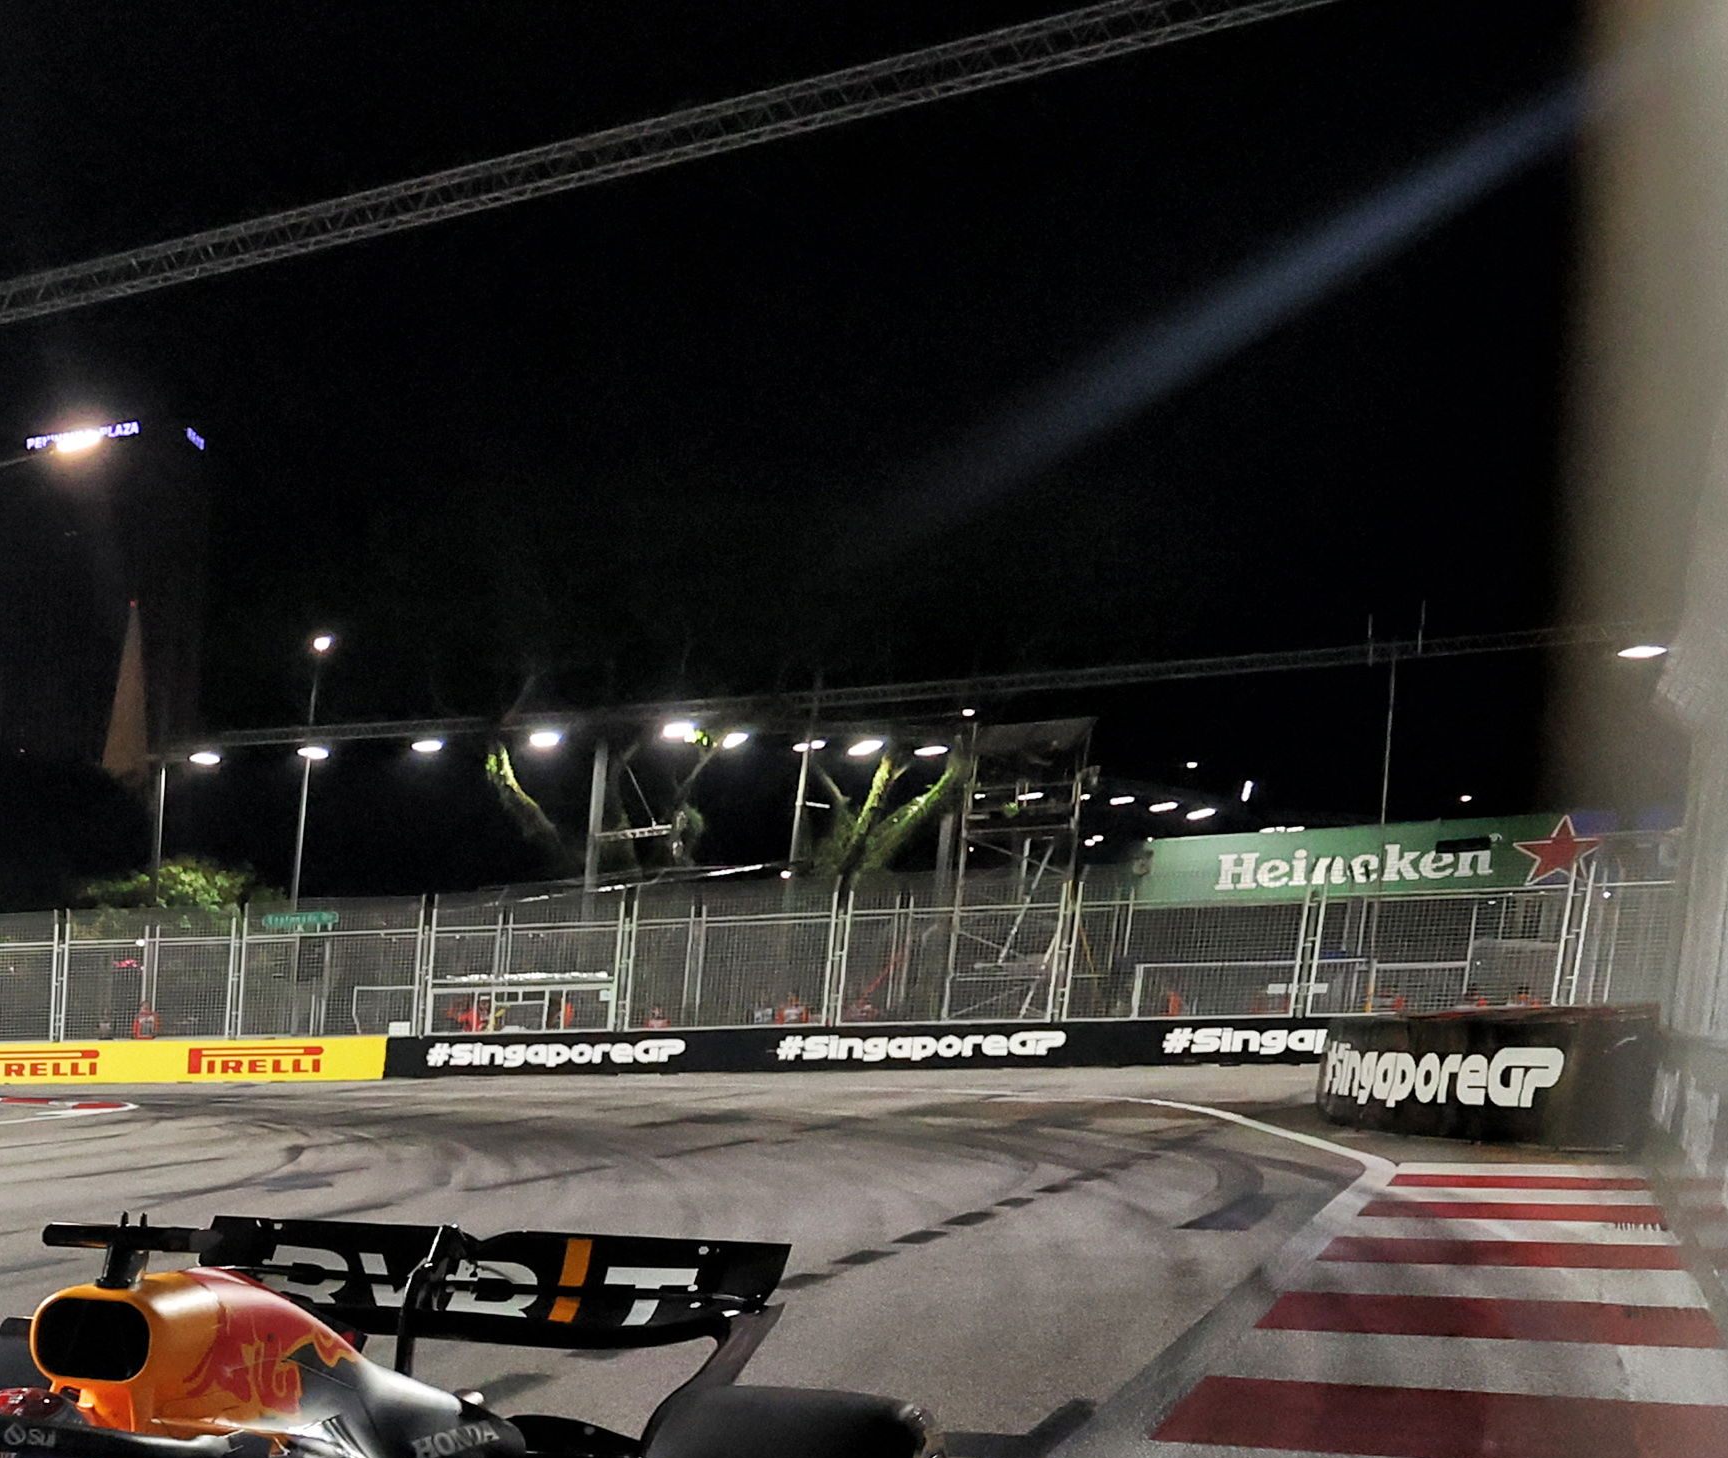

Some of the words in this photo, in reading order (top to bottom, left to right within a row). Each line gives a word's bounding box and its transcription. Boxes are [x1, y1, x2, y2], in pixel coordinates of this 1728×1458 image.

[100, 421, 140, 437] PLAZA
[1215, 843, 1493, 891] Heineken
[188, 1046, 324, 1074] PIRELLI
[426, 1038, 686, 1068] #SingaporeGP
[776, 1030, 1067, 1063] #SingaporeGP
[1324, 1040, 1565, 1108] #SingaporeGP
